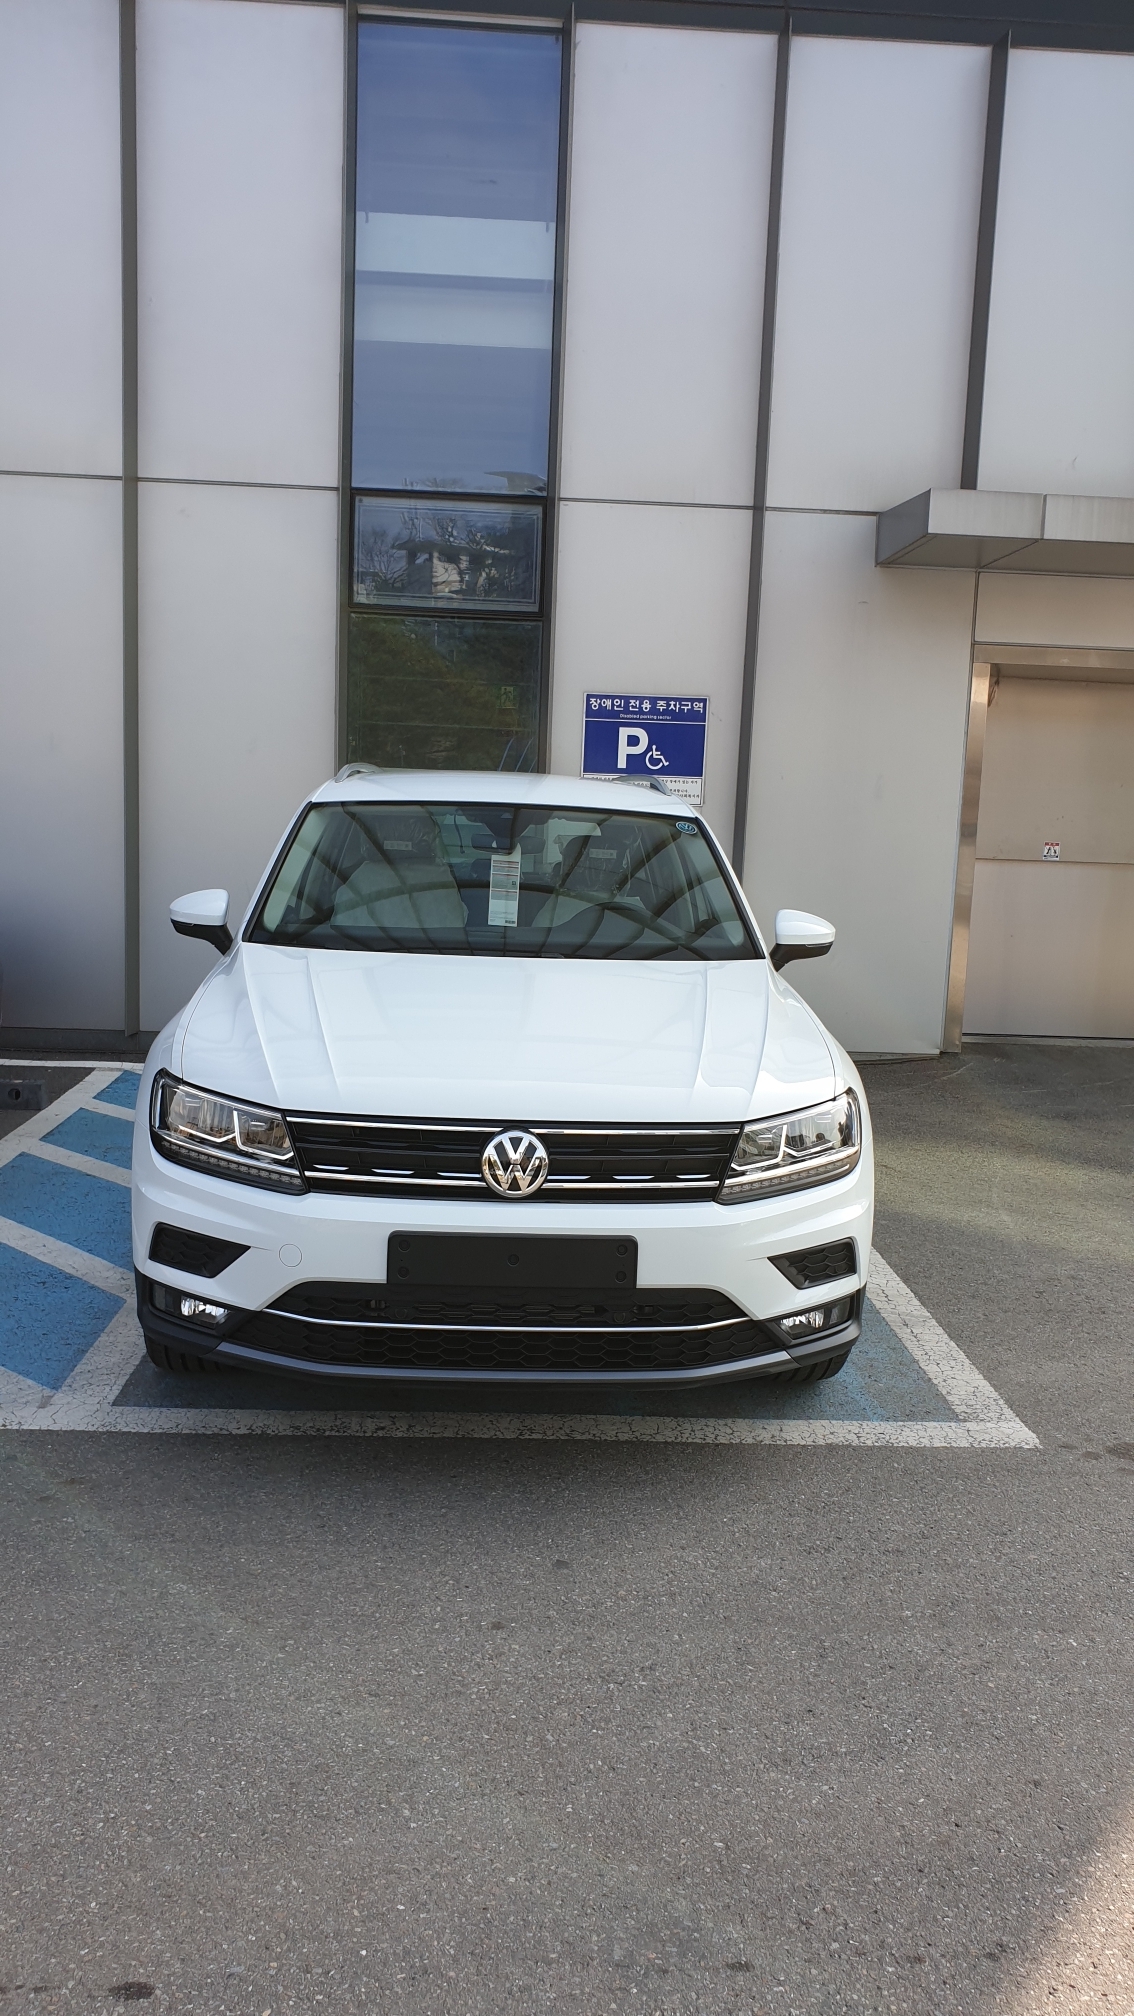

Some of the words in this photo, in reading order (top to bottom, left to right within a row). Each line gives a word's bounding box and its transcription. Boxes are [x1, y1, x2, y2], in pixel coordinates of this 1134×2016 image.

[589, 698, 624, 710] 장애인
[628, 699, 651, 711] 전용
[656, 700, 704, 713] 주차구역
[617, 727, 649, 769] P
[481, 1129, 549, 1198] VW
